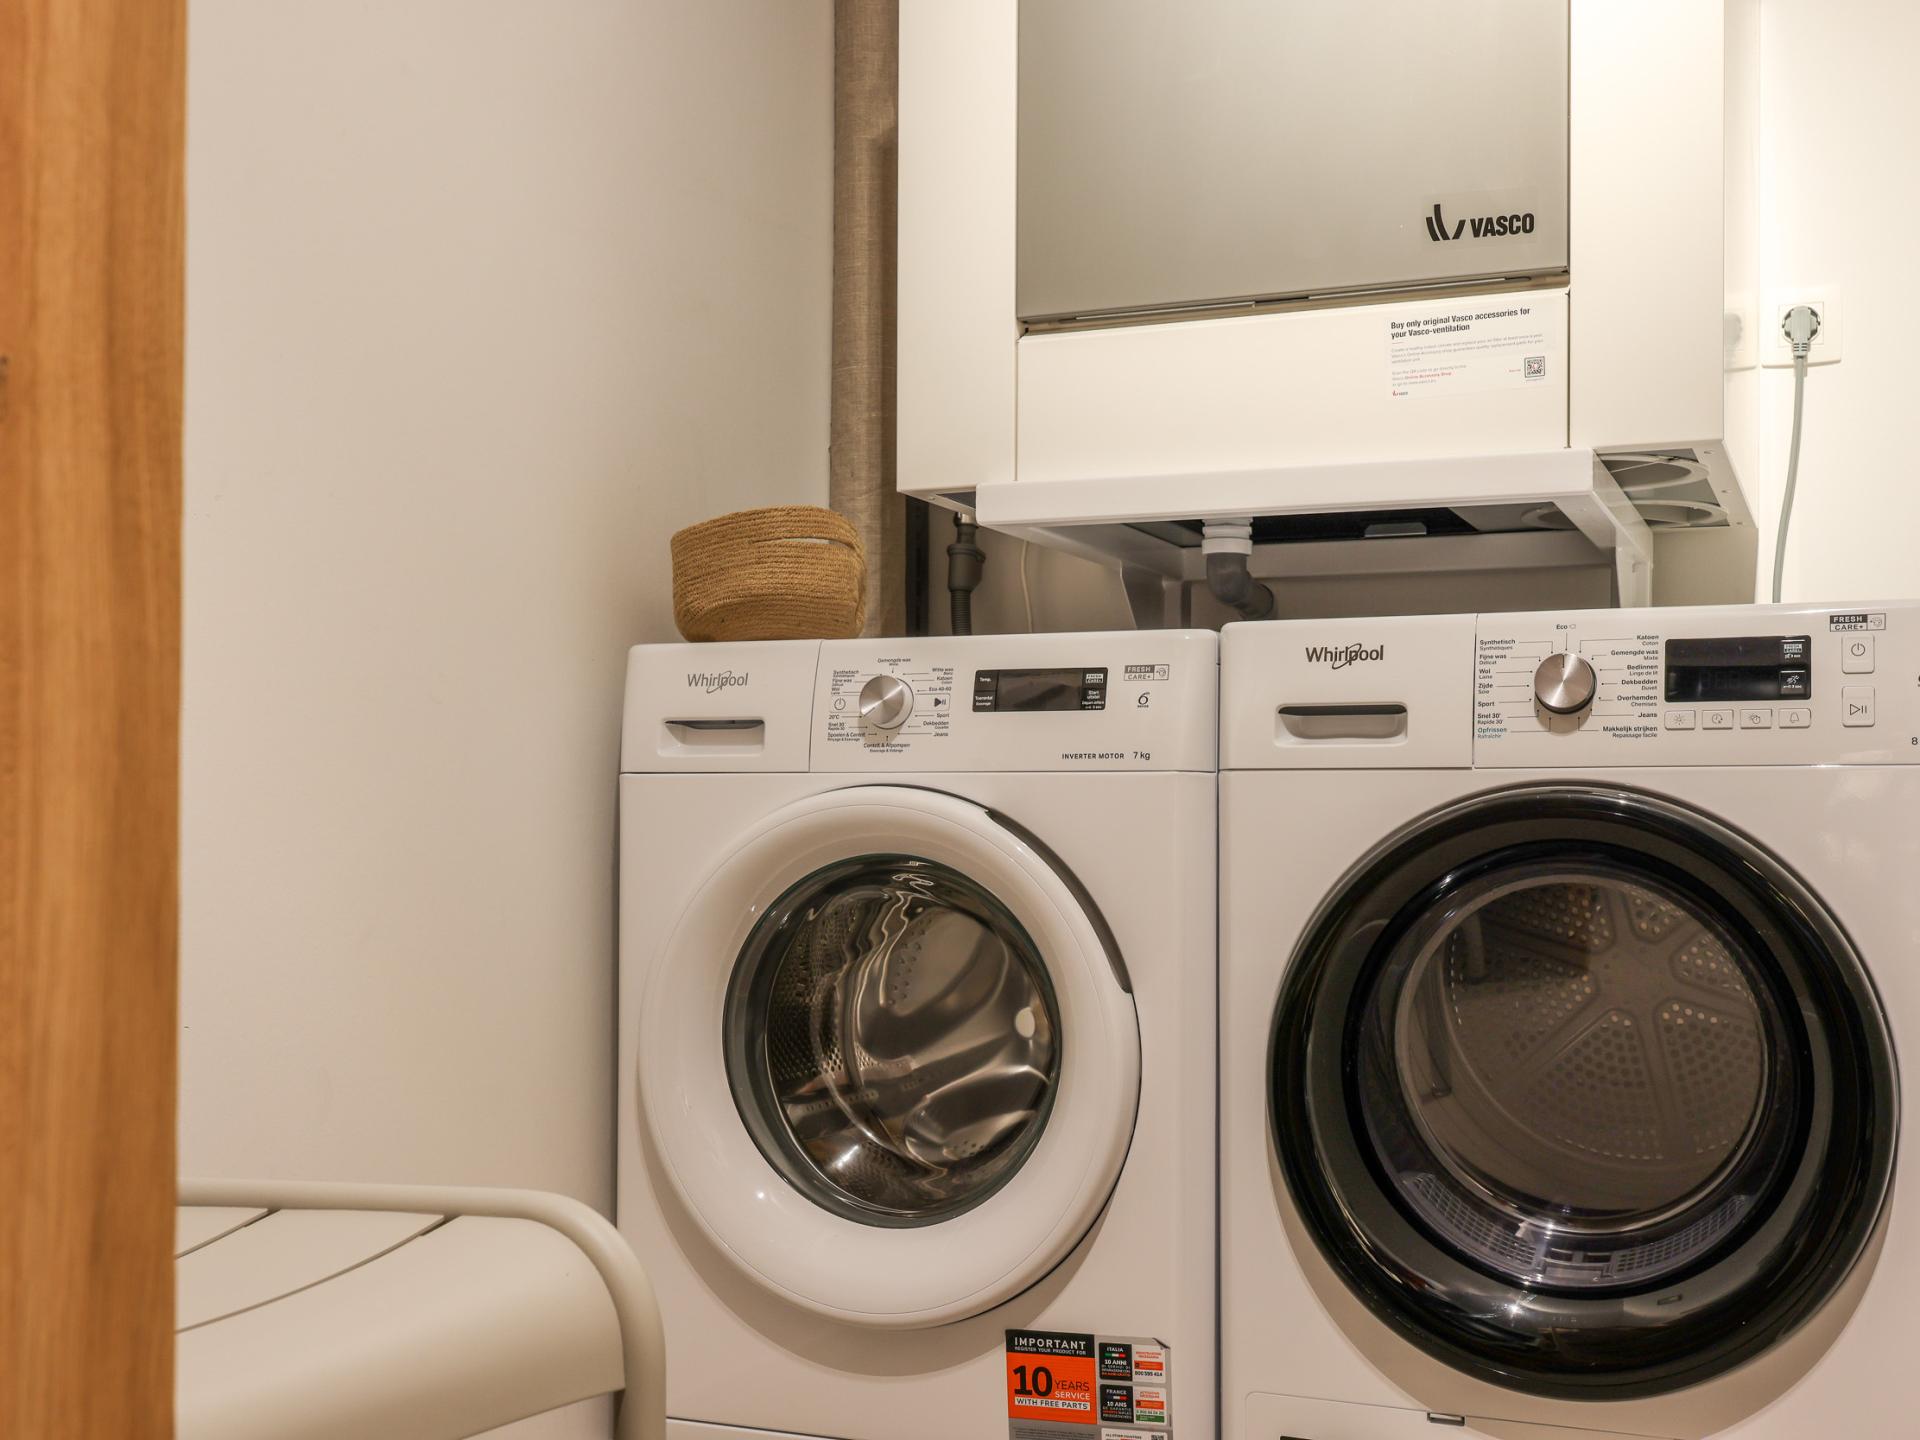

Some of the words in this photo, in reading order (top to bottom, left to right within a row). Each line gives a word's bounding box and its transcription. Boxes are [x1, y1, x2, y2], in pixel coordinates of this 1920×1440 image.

[1470, 213, 1534, 238] VASCO
[1391, 321, 1404, 330] Buy
[1406, 319, 1420, 328] only
[1423, 316, 1450, 326] original
[1452, 314, 1473, 322] Vasco
[1475, 310, 1518, 320] accessories
[1391, 331, 1406, 340] your
[1408, 324, 1470, 336] Vasco-ventilation
[1305, 643, 1384, 670] Whirlpool
[688, 671, 748, 694] Whirlpool
[1912, 737, 1918, 746] 8
[1133, 752, 1138, 760] 7
[1140, 751, 1150, 760] kg
[1014, 1337, 1086, 1350] IMPORTANT
[1013, 1366, 1052, 1396] 10
[1055, 1380, 1090, 1391] YEARS
[1055, 1391, 1090, 1400] SERVICE
